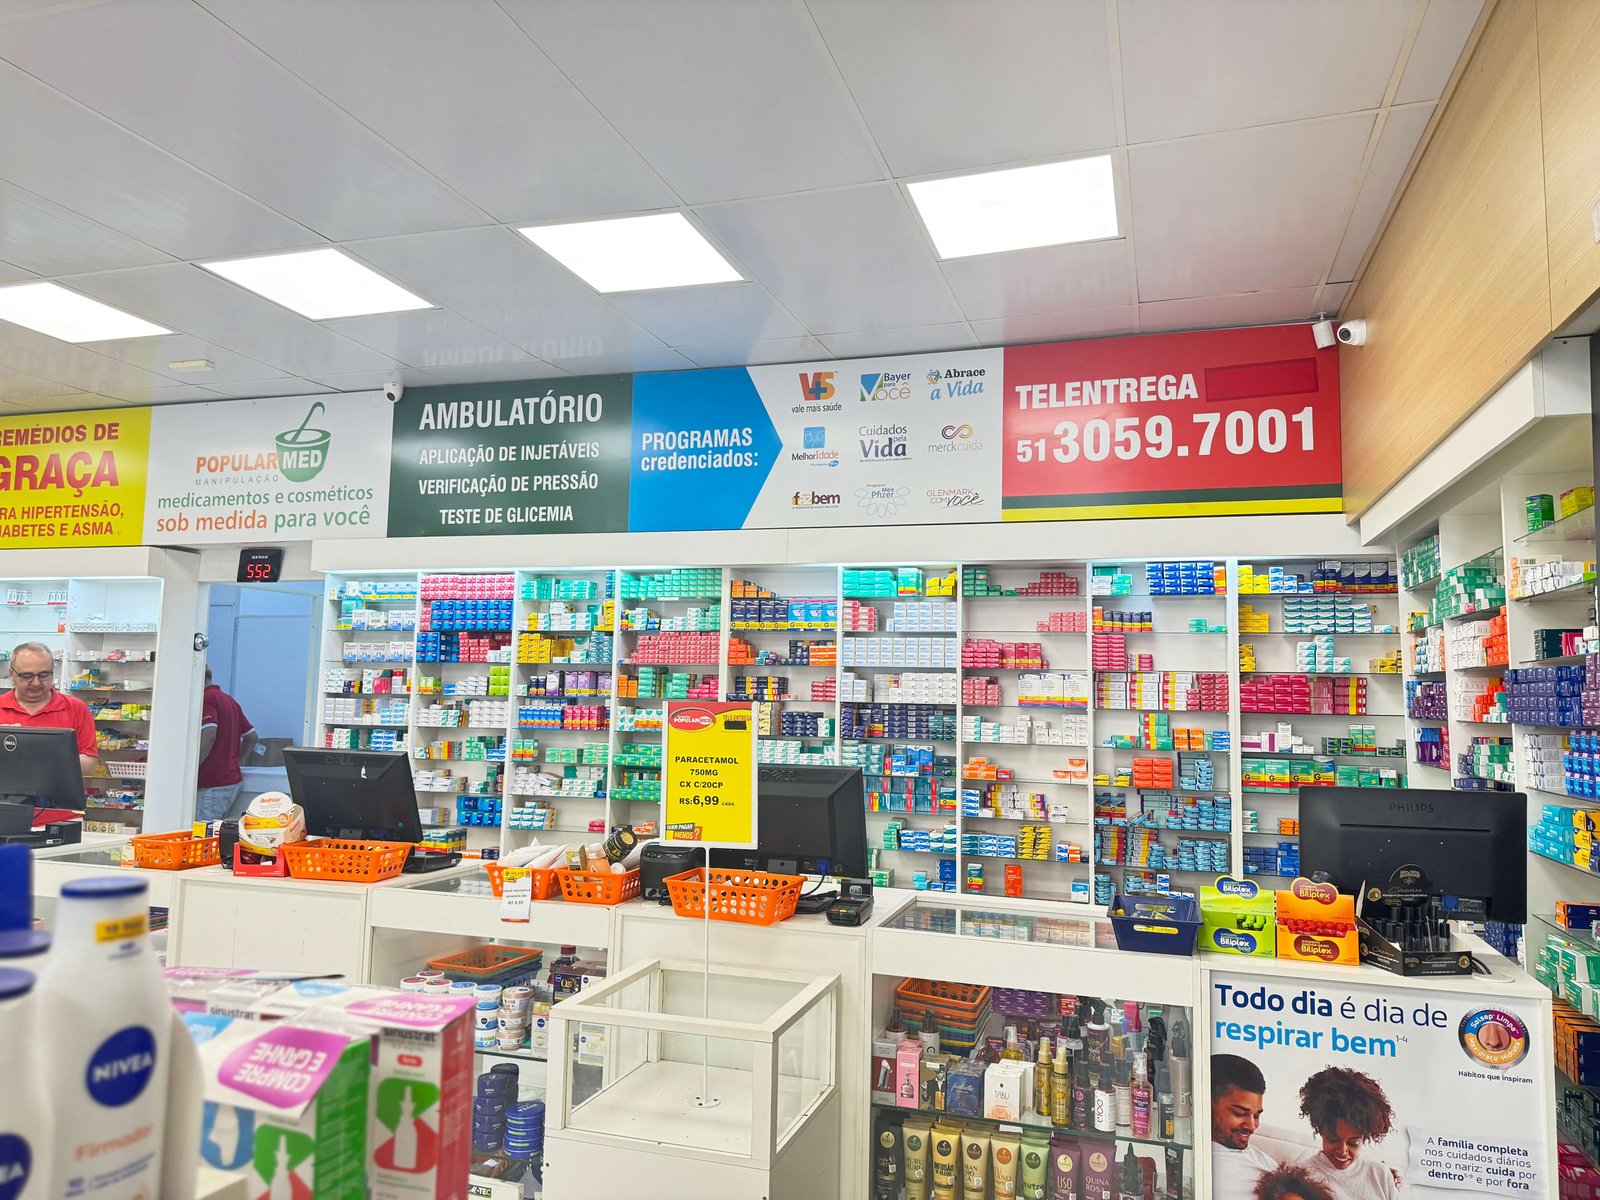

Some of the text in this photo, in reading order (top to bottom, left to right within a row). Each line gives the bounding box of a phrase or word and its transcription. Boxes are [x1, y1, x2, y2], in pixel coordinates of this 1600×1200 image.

[884, 372, 911, 383] Bayer
[944, 369, 986, 379] Abrace
[930, 380, 985, 400] a Vida
[1015, 373, 1199, 410] TELENTREGA
[419, 389, 603, 431] AMBULATÓRIO
[791, 402, 842, 413] vale mais saúde
[0, 422, 120, 447] EMÉDIOS DE
[641, 427, 753, 451] PROGRAMAS
[859, 424, 907, 436] Cuidados
[893, 435, 907, 443] pela
[1016, 406, 1315, 464] 51 3059.7001
[419, 440, 600, 467] APLICAÇÃO DE INJETÁVEIS
[859, 437, 907, 458] Vida
[282, 449, 322, 469] MED
[641, 449, 759, 472] credenciados:
[195, 474, 279, 486] MANIPULAÇÃO
[418, 470, 599, 497] VERIFICAÇÃO DE PRESSÃO
[158, 485, 373, 509] medicamentos e cosméticos
[871, 491, 894, 499] Pfizer
[927, 488, 974, 498] GLENMARK
[21, 499, 124, 519] HIPERTENSÃO,
[156, 504, 371, 533] sob medida para você
[440, 505, 573, 525] TESTE DE GLICEMIA
[60, 523, 68, 536] E
[72, 521, 113, 536] ASMA
[247, 563, 271, 579] 552
[675, 756, 739, 765] PARACETAMOL
[690, 768, 718, 776] 750MG
[1389, 801, 1435, 813] PHILIPS
[1223, 885, 1250, 893] Biliplex
[1299, 890, 1330, 899] Biliplex
[1220, 938, 1250, 947] Biliplex
[1301, 945, 1332, 955] Biliplex
[210, 1005, 255, 1020] sinustrat
[1214, 983, 1285, 1013] Todo
[1291, 990, 1333, 1017] dia
[1340, 996, 1356, 1019] é
[1363, 998, 1405, 1025] dia
[1412, 1002, 1448, 1028] de
[1470, 1014, 1493, 1029] Salsep
[1496, 1013, 1516, 1032] Limpa
[1214, 1020, 1327, 1053] respirar
[1331, 1027, 1396, 1057] bem
[248, 1041, 328, 1073] E GANHE
[1468, 1037, 1498, 1061] Maxidrate
[93, 1054, 152, 1084] NIVEA
[232, 1062, 312, 1093] COMPRE
[1458, 1070, 1485, 1079] Hábitos
[1502, 1074, 1533, 1084] inspiram
[994, 1090, 1009, 1100] TABU
[1427, 1136, 1528, 1157] A família completa
[1425, 1148, 1531, 1169] nos cuidados diários
[1420, 1158, 1442, 1168] com
[1455, 1162, 1483, 1173] nariz:
[1486, 1166, 1515, 1177] cuida
[1518, 1171, 1536, 1180] por
[1085, 1175, 1109, 1186] QUINA
[1428, 1169, 1464, 1181] dentro
[1486, 1177, 1503, 1187] por
[1507, 1178, 1530, 1190] fora
